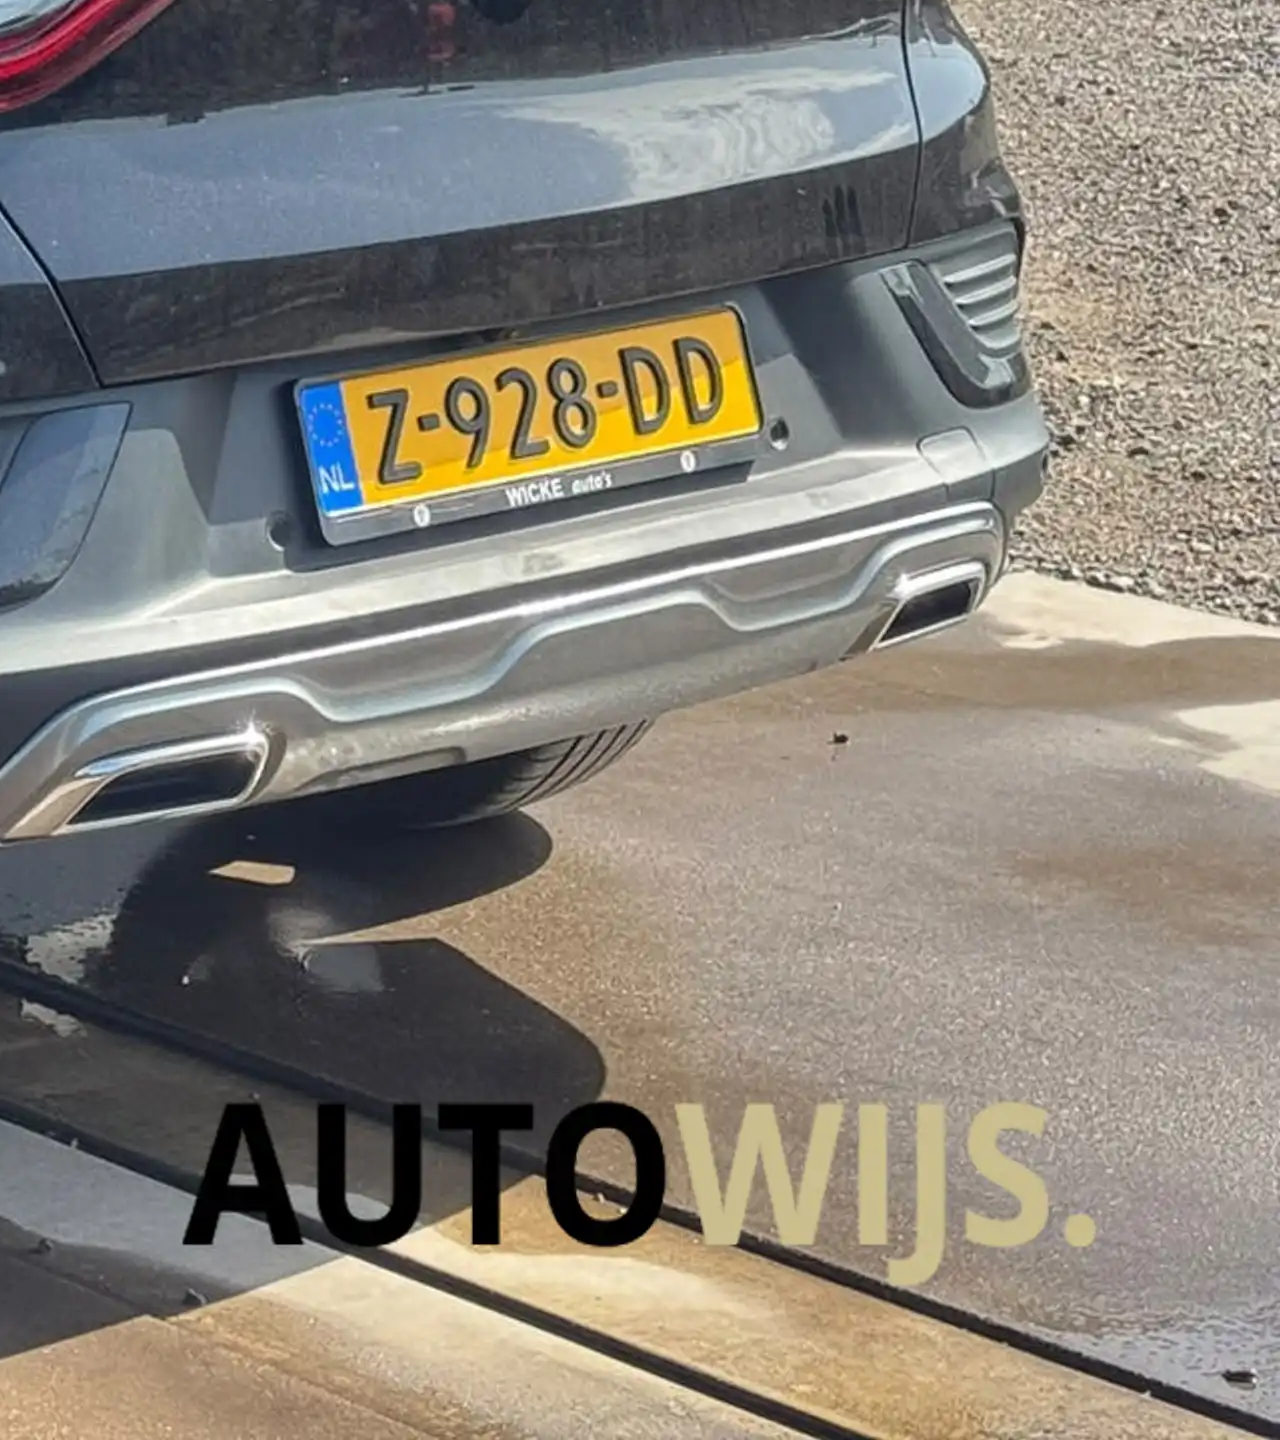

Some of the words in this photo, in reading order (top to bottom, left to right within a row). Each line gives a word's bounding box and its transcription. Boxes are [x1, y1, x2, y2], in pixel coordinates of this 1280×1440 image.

[366, 336, 723, 485] Z-928-DD
[317, 464, 356, 494] NL
[506, 478, 564, 508] WICKE
[572, 470, 613, 496] auto's
